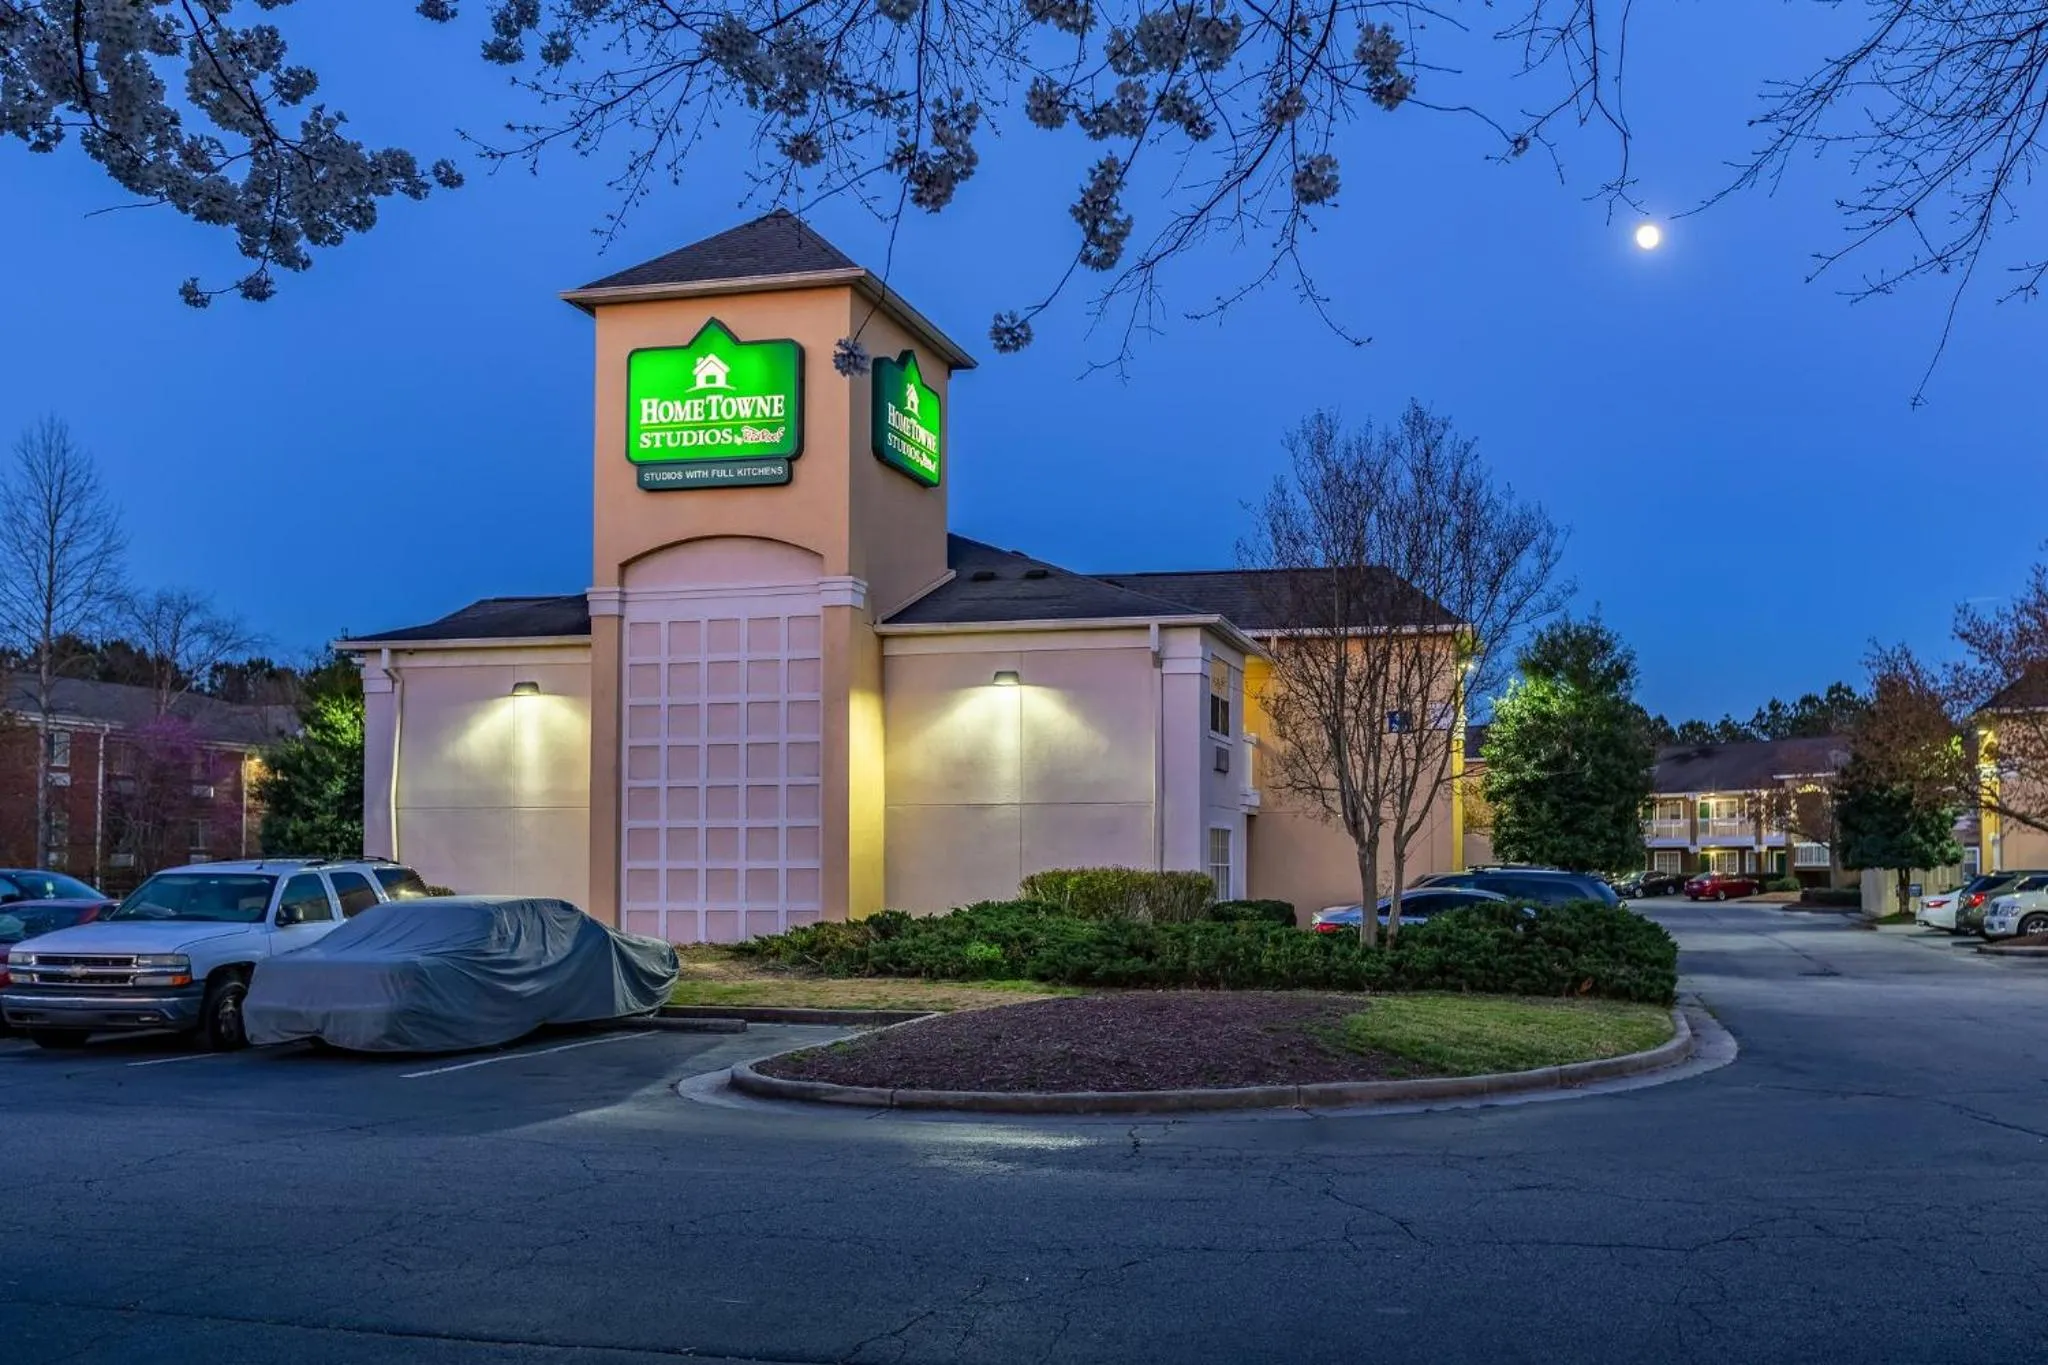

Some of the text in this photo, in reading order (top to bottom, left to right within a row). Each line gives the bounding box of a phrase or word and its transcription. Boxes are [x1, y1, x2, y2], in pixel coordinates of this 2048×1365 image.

[639, 428, 733, 449] STUDIOS
[643, 466, 784, 482] STUDIOS WITH FULL KITCHENS
